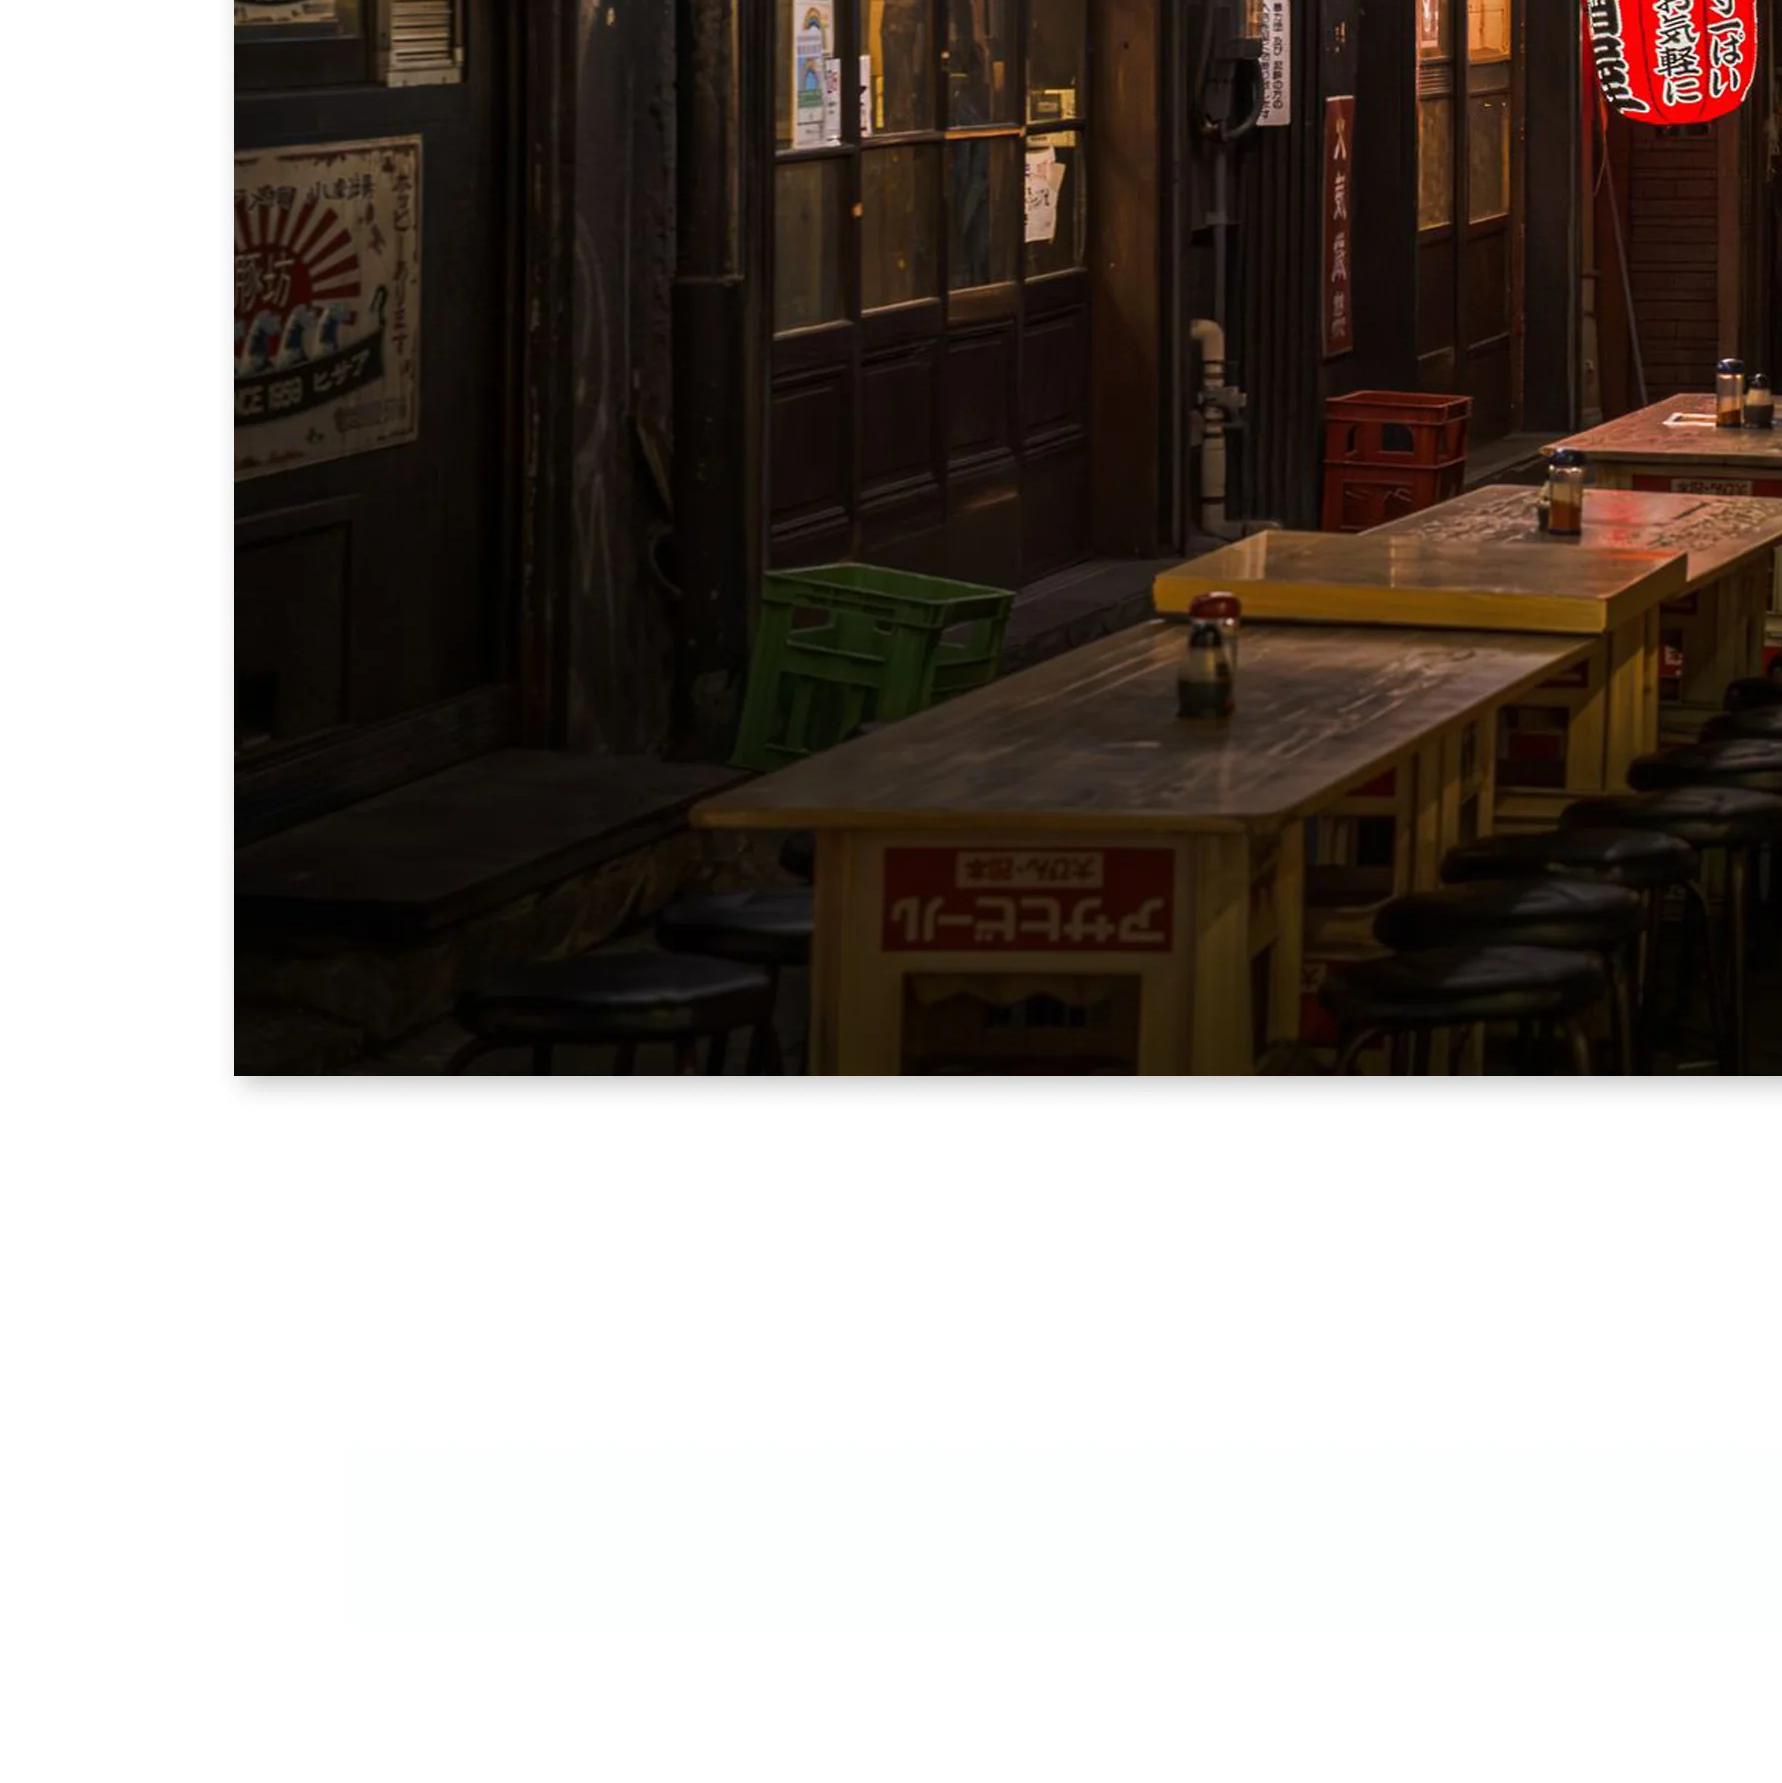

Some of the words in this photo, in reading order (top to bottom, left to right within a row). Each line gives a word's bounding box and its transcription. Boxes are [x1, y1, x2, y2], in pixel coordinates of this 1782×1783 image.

[891, 895, 1166, 944] アサヒビール
